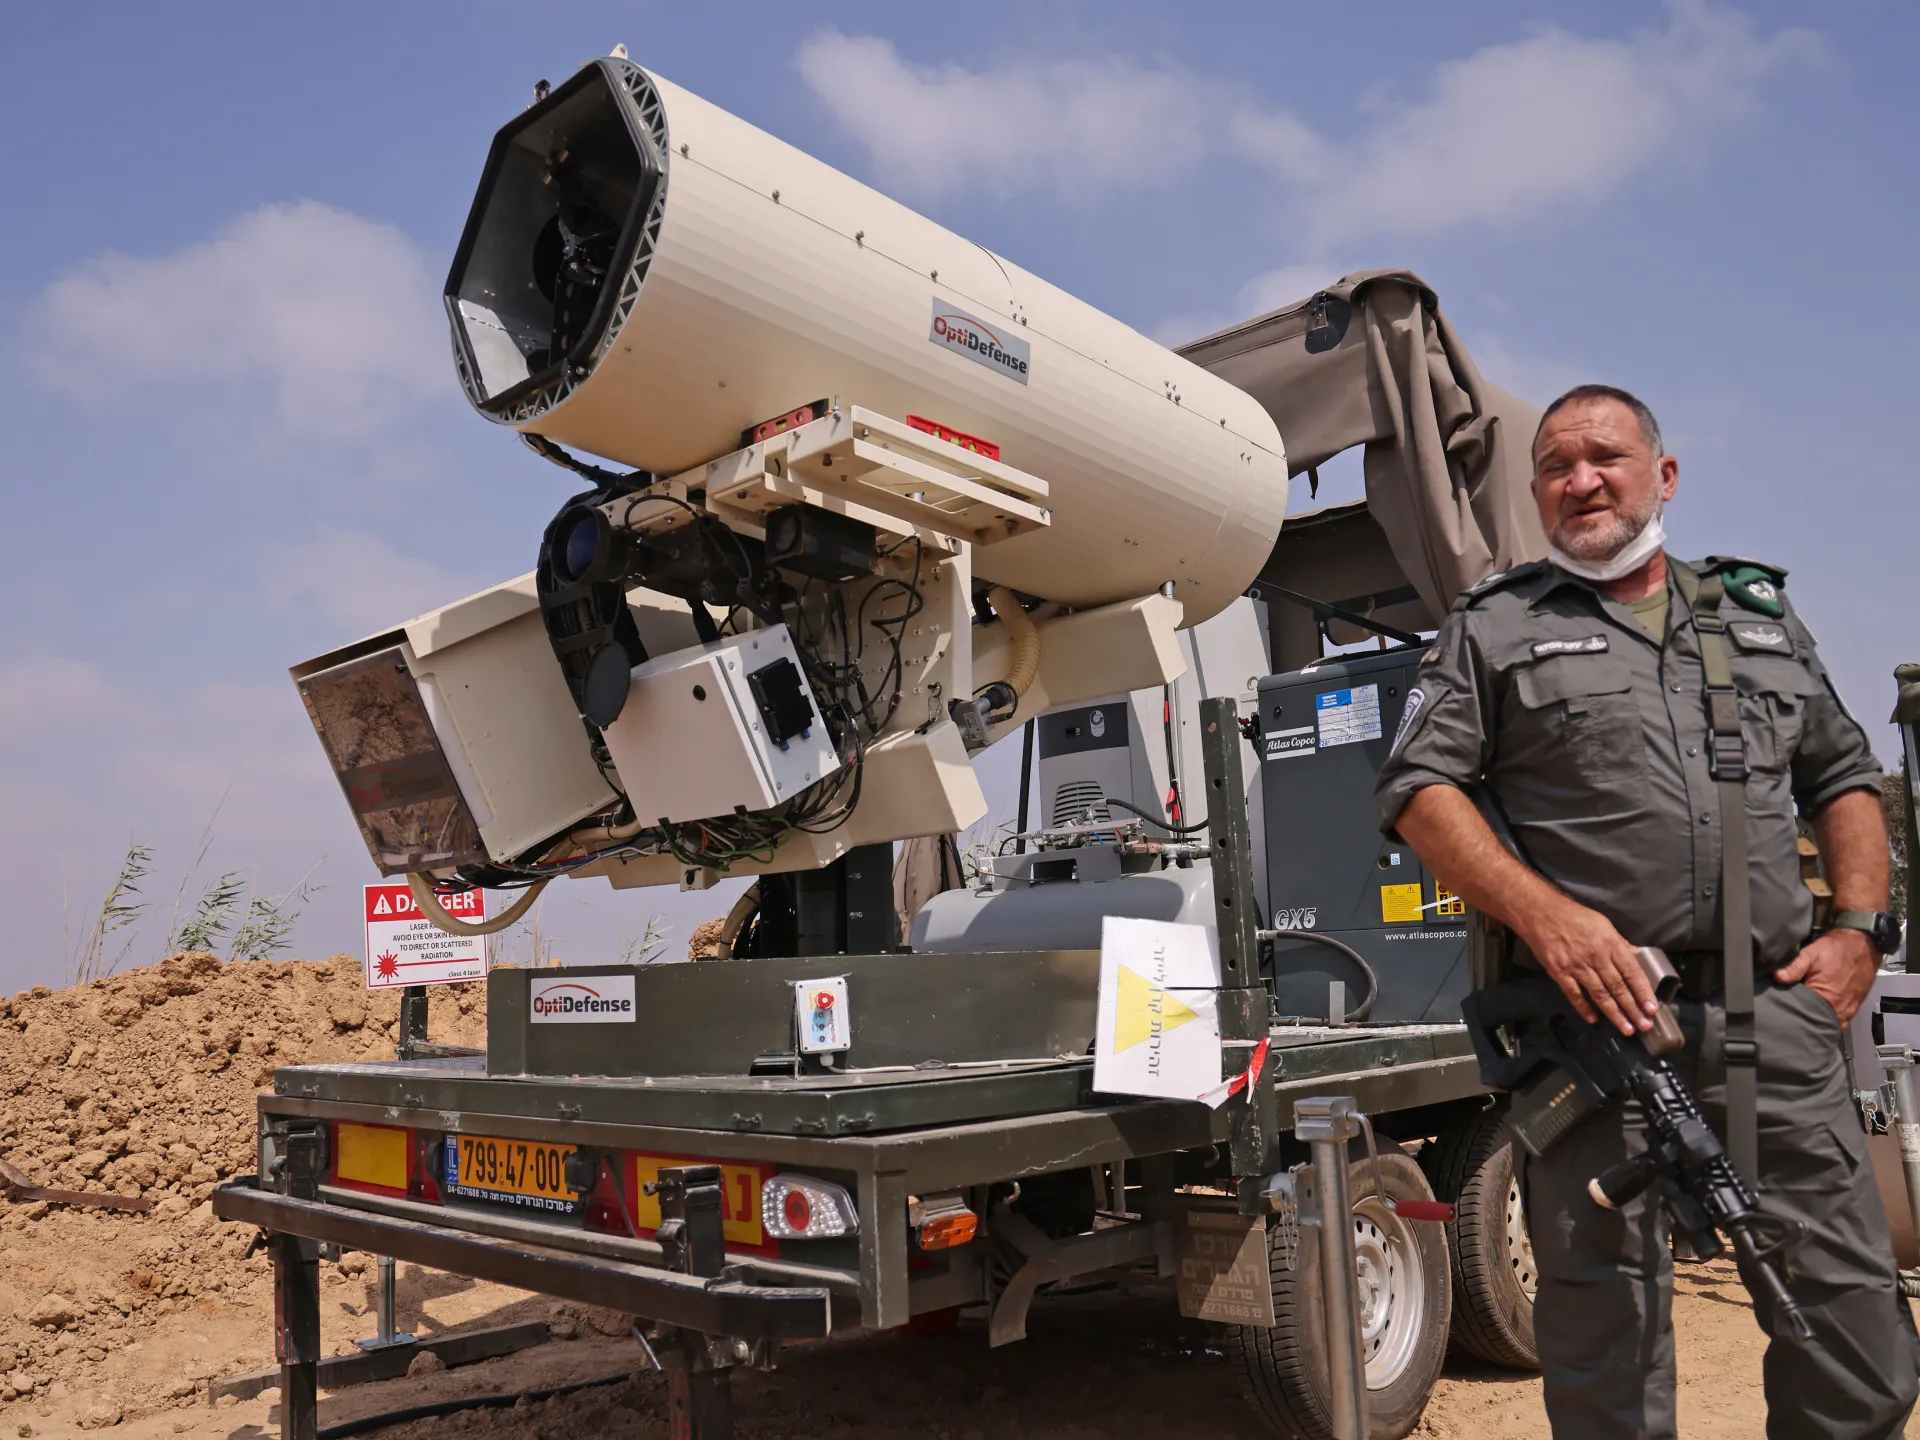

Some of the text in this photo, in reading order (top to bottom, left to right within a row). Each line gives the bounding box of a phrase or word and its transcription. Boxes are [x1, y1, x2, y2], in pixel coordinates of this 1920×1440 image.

[934, 316, 1027, 374] OptiDefense
[1266, 739, 1291, 751] Atlas
[1291, 737, 1316, 748] Copco
[1275, 908, 1316, 930] GX5
[410, 923, 429, 931] LASER
[393, 934, 412, 942] AVOID
[1385, 930, 1468, 941] www.atlascopco.co
[440, 940, 473, 948] SCATTERED
[421, 951, 454, 960] RADIATION
[533, 996, 631, 1017] OptiDefense
[448, 1148, 457, 1168] IL
